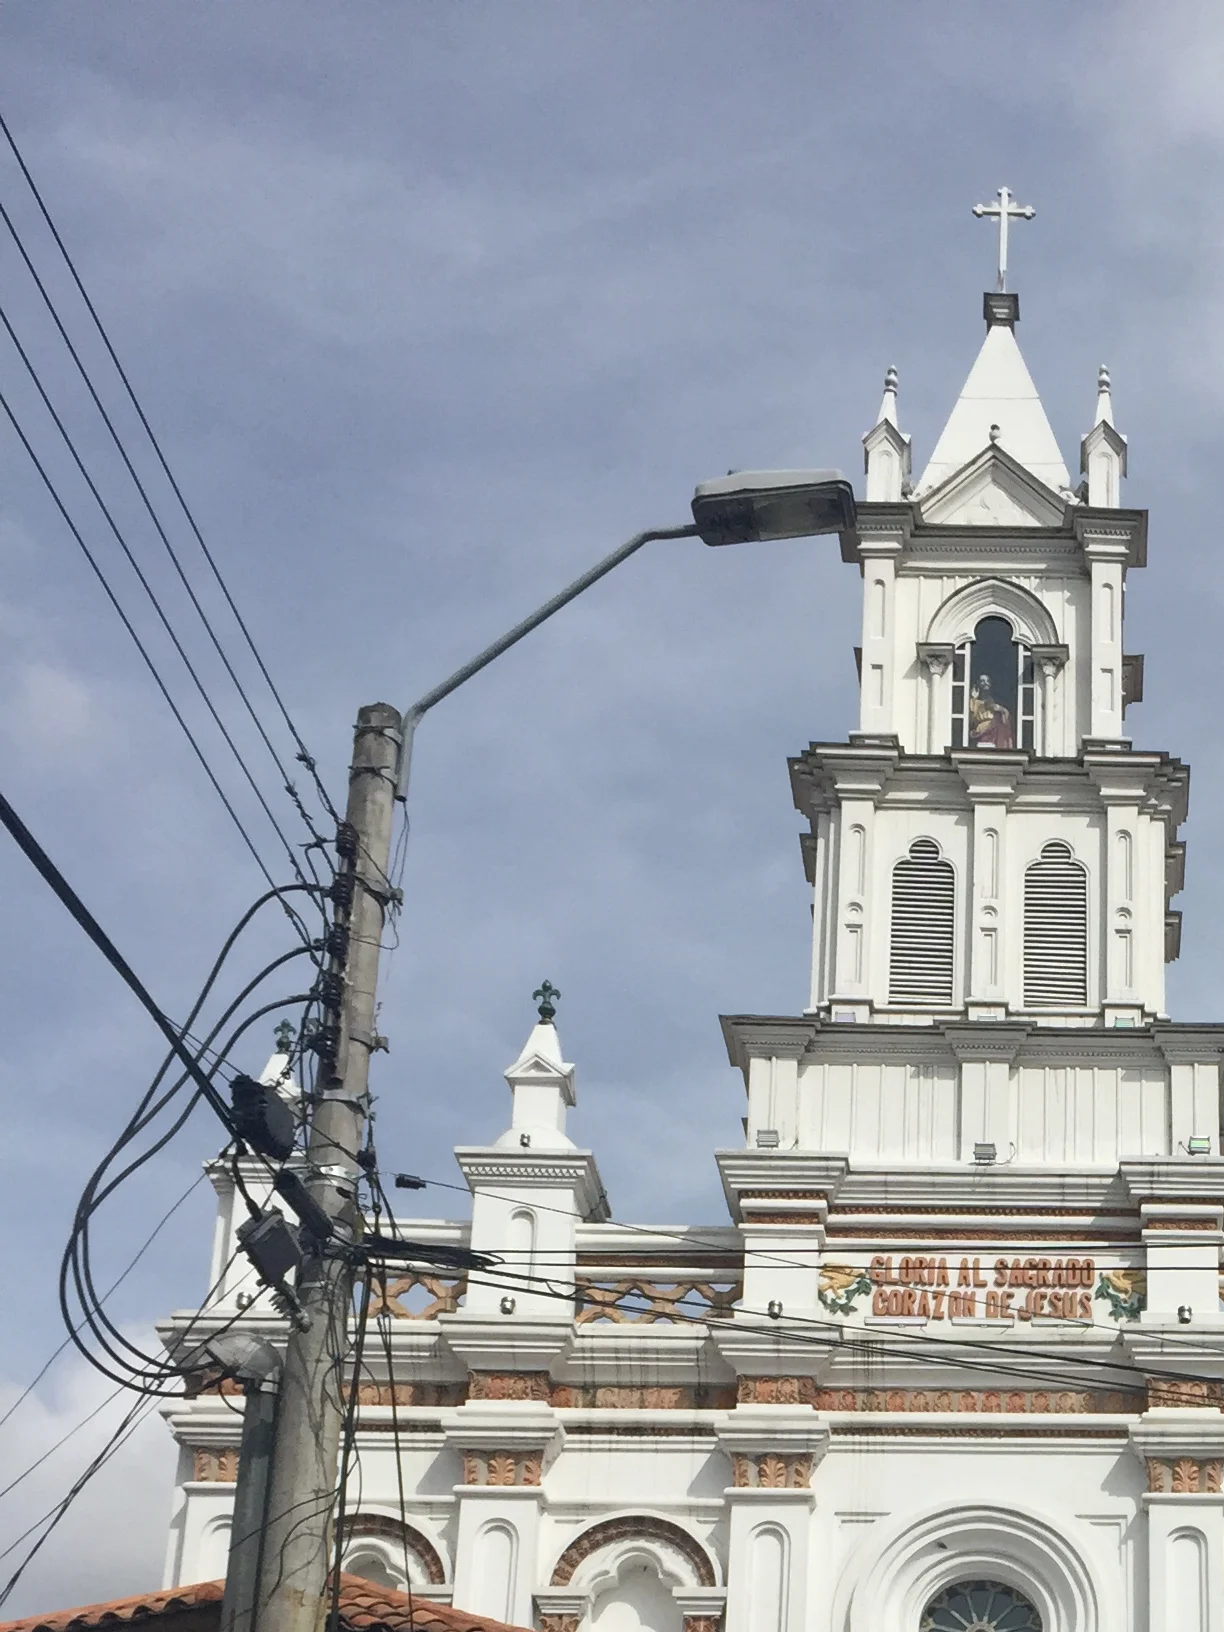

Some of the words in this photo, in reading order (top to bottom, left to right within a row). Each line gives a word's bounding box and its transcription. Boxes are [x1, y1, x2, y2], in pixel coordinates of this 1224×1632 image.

[870, 1256, 949, 1288] GLORIA
[957, 1257, 988, 1288] AL
[993, 1258, 1095, 1290] SAGRADO
[872, 1288, 976, 1320] CORAZON
[986, 1290, 1015, 1319] DE
[1018, 1290, 1092, 1321] JESUS
